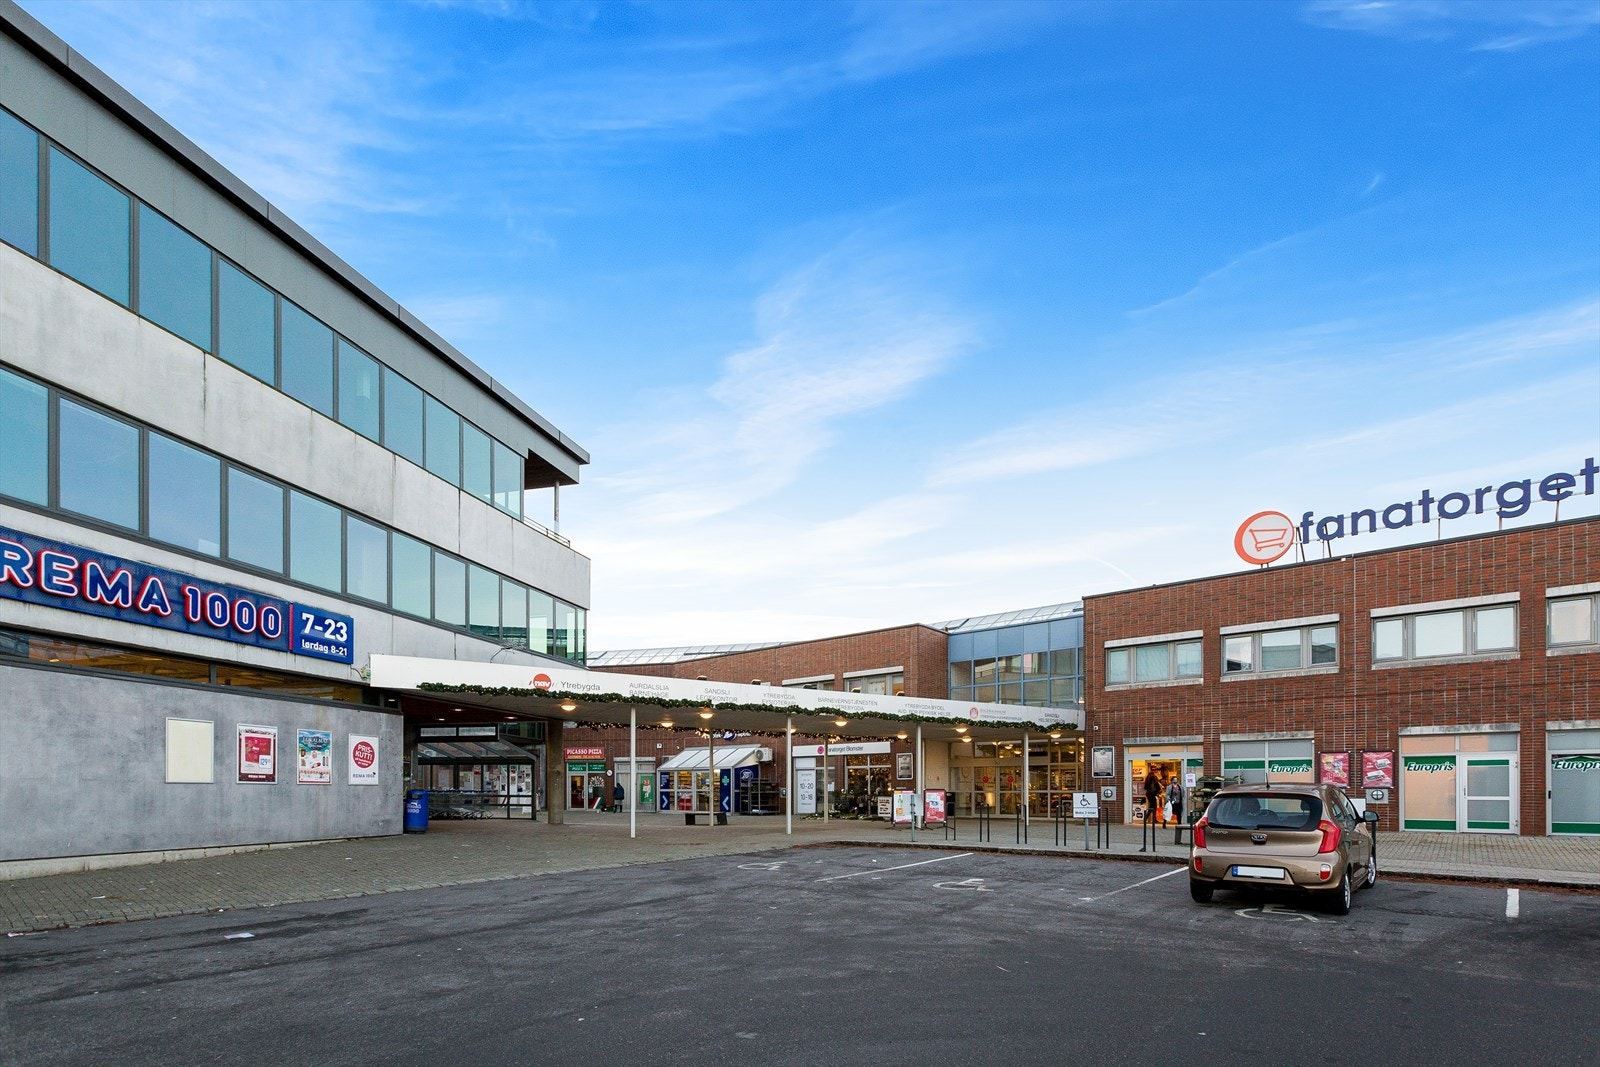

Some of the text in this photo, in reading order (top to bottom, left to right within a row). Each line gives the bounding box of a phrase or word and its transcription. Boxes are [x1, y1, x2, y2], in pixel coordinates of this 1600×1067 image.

[1301, 457, 1600, 544] fanatorget
[0, 538, 282, 640] REMA 1000
[302, 613, 348, 642] 7-23
[331, 645, 348, 656] 8-21
[561, 681, 600, 691] Ytrebygda
[629, 683, 669, 691] AURDALSLIA
[357, 744, 373, 754] PRIS-
[846, 745, 864, 753] Blomster
[355, 750, 373, 761] KUTT!
[1271, 763, 1311, 775] Europris
[1406, 761, 1454, 773] Europris
[1554, 760, 1600, 772] Europr
